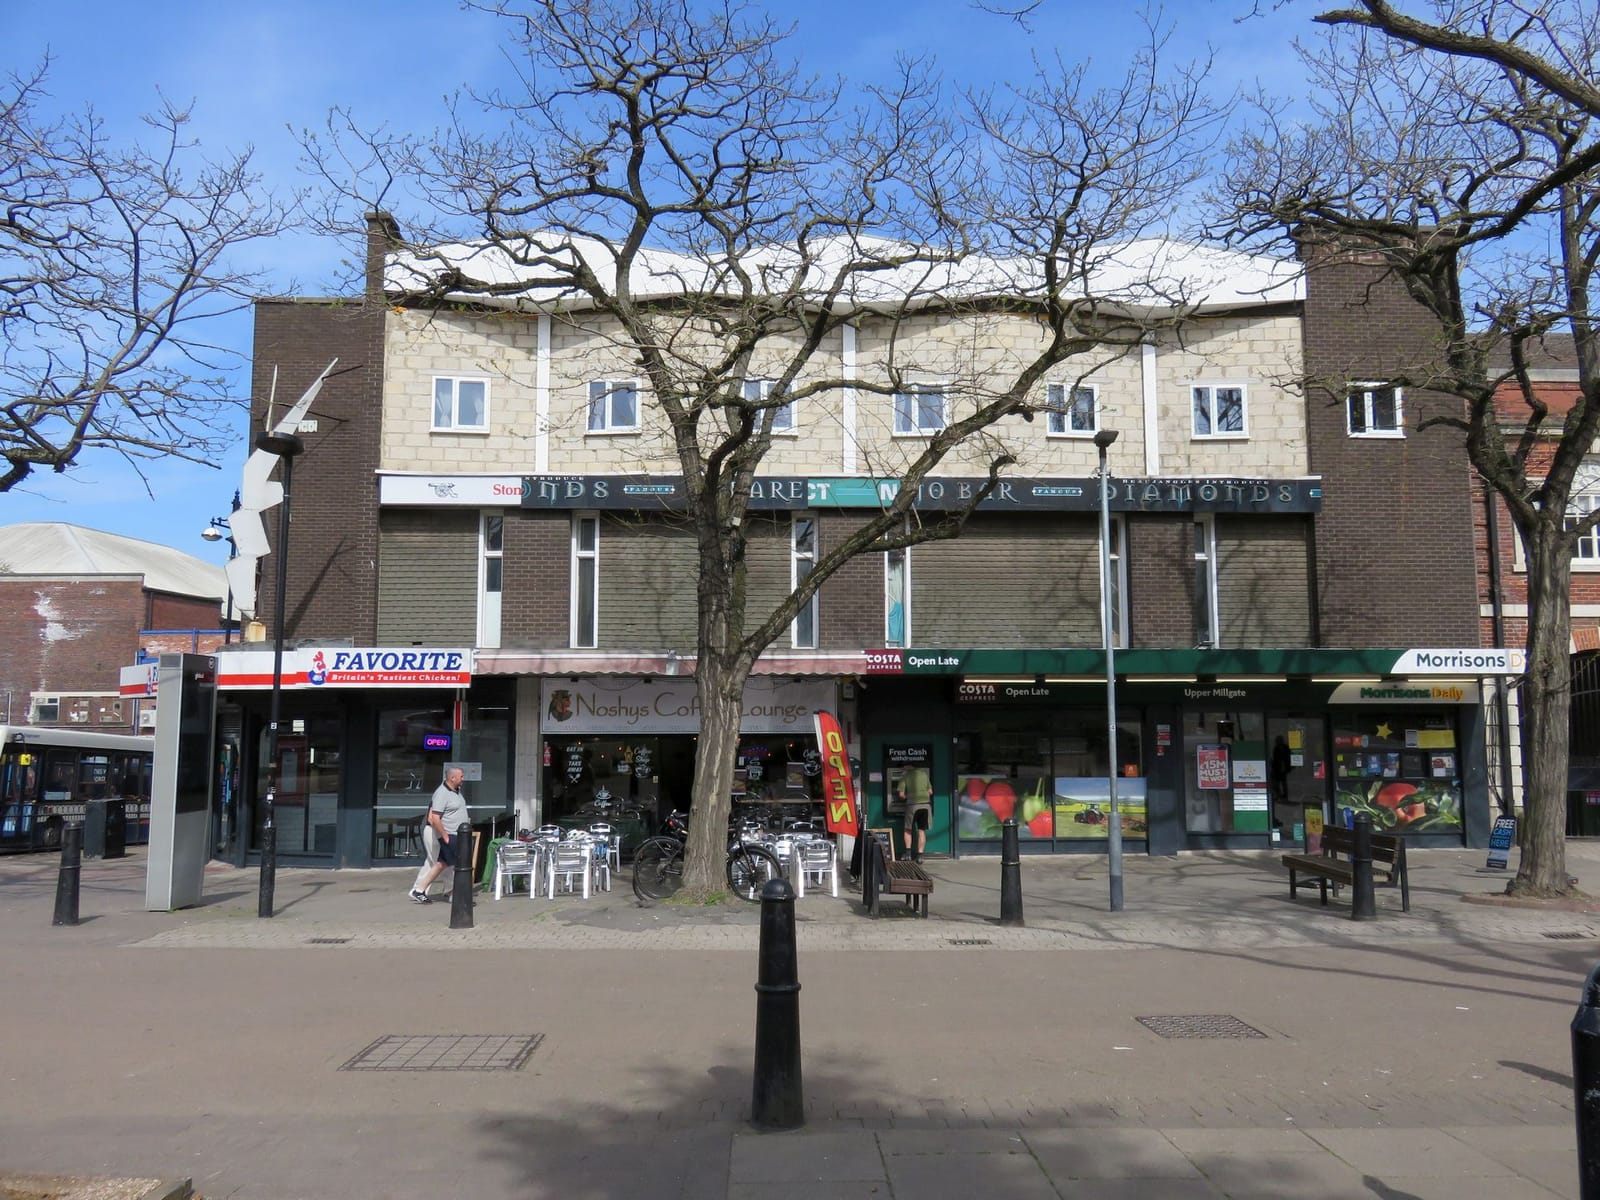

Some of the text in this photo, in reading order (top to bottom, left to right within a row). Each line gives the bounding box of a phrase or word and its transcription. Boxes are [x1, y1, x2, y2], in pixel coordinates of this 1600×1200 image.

[493, 483, 522, 496] Ston
[332, 652, 463, 671] FAVORITE
[867, 654, 901, 664] COSTA
[909, 656, 960, 668] Open Late
[1416, 652, 1505, 668] Morrisons
[332, 674, 461, 682] Britain's Tastiest Chicken!
[959, 685, 996, 695] COSTA
[1005, 687, 1050, 698] Open Late
[1184, 687, 1247, 699] Upper Millgate
[1360, 686, 1464, 701] Morrisons Daily
[576, 692, 650, 725] Noshys
[741, 703, 808, 724] ounge
[426, 738, 448, 747] OPEN
[889, 748, 928, 757] Free Cash
[1495, 819, 1515, 828] FREE
[1493, 828, 1512, 836] CASH
